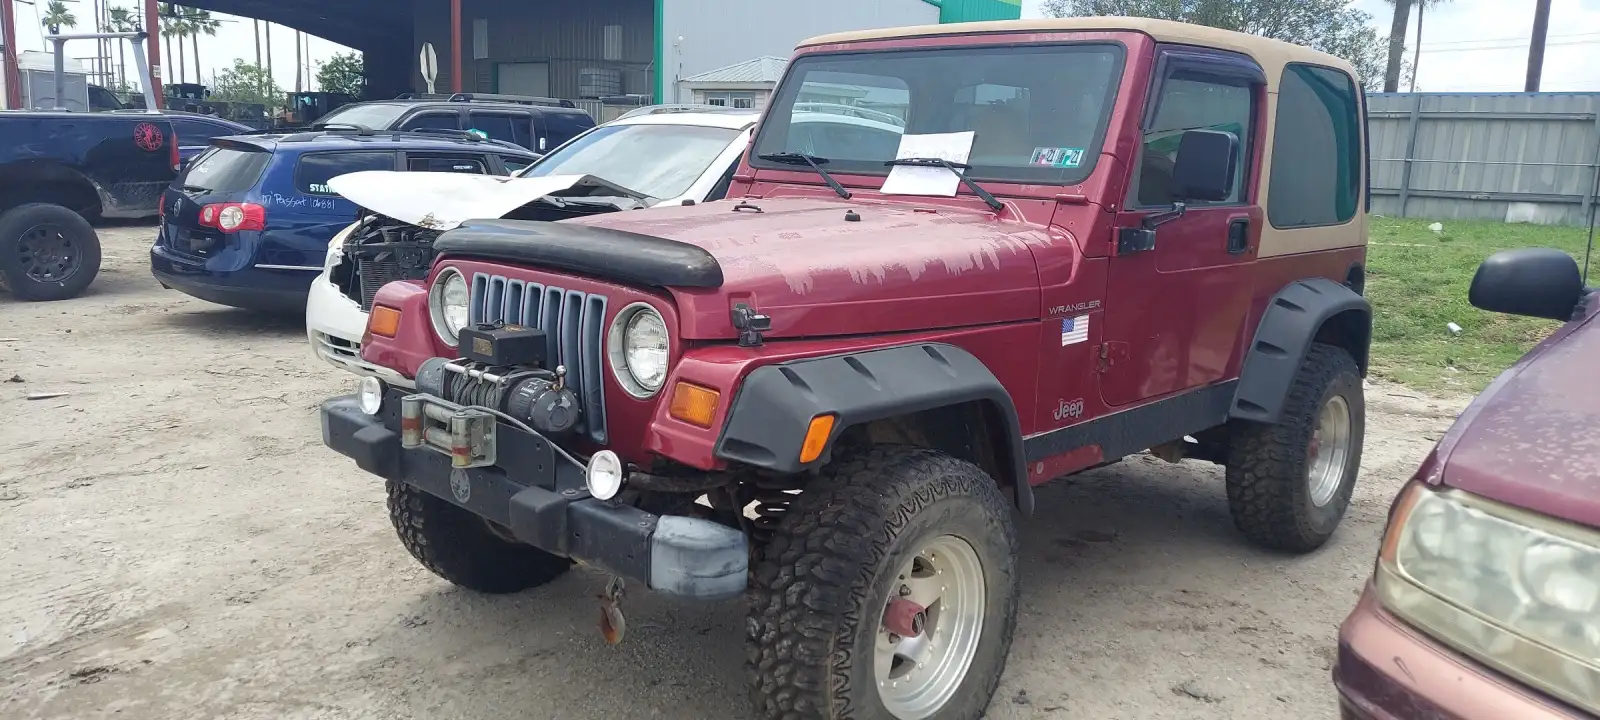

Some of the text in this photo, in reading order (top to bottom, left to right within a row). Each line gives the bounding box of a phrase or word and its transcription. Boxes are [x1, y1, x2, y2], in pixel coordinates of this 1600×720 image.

[274, 193, 307, 208] Passat
[1049, 300, 1101, 315] WRANGLER
[1053, 398, 1084, 421] Jeep
